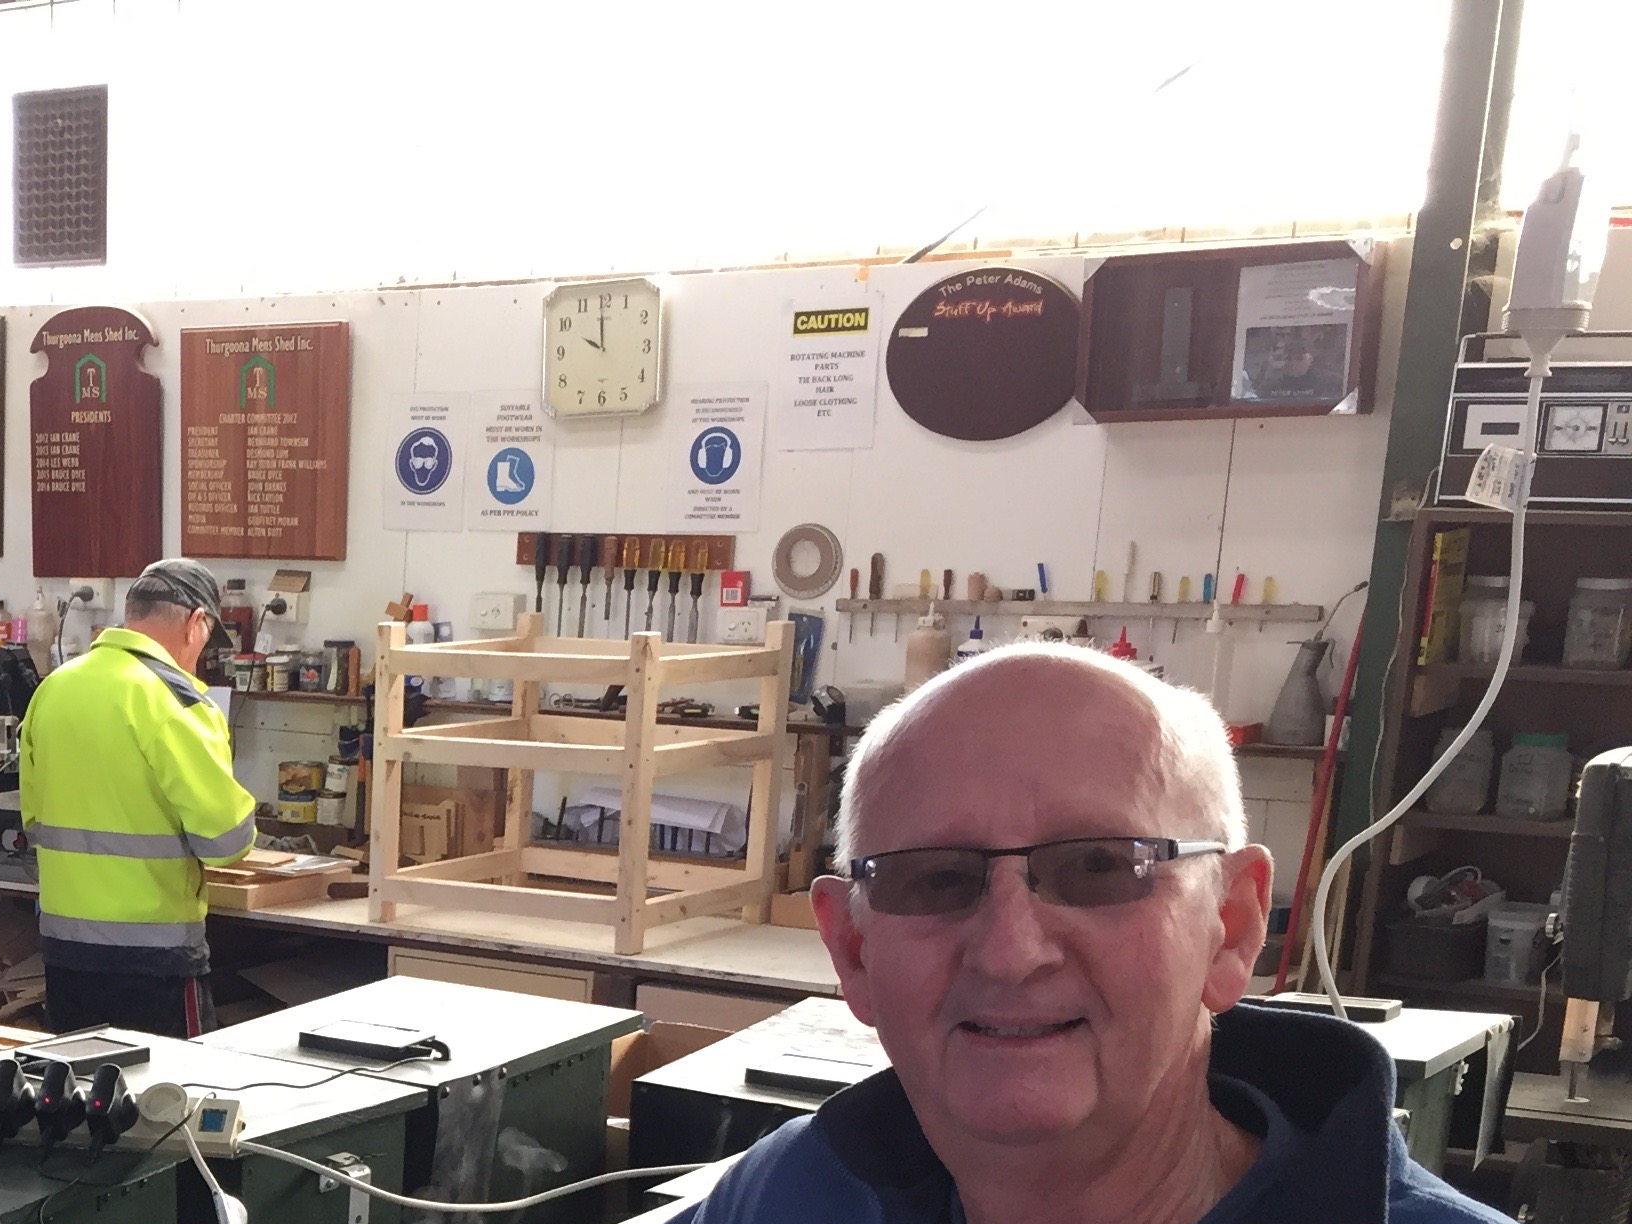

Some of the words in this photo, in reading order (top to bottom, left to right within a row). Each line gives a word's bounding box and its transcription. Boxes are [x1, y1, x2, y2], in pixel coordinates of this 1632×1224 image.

[938, 282, 963, 297] The
[966, 274, 1001, 286] Peter
[1004, 273, 1043, 295] Adams
[577, 298, 588, 313] 11
[599, 293, 612, 309] 12
[623, 294, 628, 309] 1
[640, 309, 648, 325] 2
[977, 301, 997, 321] Up
[1002, 299, 1043, 317] Award
[559, 316, 572, 332] 10
[796, 312, 866, 331] CAUTION
[42, 331, 82, 349] Thurgoona
[83, 328, 103, 342] Mens
[104, 326, 123, 342] Shed
[125, 325, 139, 340] Inc.
[205, 338, 249, 358] Thurgoona
[251, 337, 273, 352] Mens
[274, 335, 295, 352] Shed
[297, 335, 313, 351] Inc.
[556, 345, 565, 361] 9
[642, 338, 651, 354] 3
[790, 352, 829, 361] ROTATING
[831, 350, 866, 359] MACHINE
[87, 367, 96, 387] T
[253, 367, 263, 387] T
[558, 373, 567, 388] 8
[637, 367, 645, 383] 4
[798, 376, 810, 384] TIE
[812, 375, 832, 383] BACK
[834, 374, 854, 382] LONG
[81, 386, 100, 399] MS
[247, 387, 267, 399] MS
[577, 389, 585, 405] 7
[597, 389, 606, 406] 6
[619, 386, 628, 402] 5
[816, 386, 834, 394] HAIR
[500, 404, 531, 412] SUITABLE
[794, 399, 818, 407] LOOSE
[819, 398, 857, 406] CLOTHING
[71, 410, 112, 423] PRESIDENTS
[218, 412, 246, 424] CHARTER
[247, 412, 282, 424] COMMITTEE
[817, 409, 832, 417] ETC
[36, 432, 49, 443] 2012
[50, 432, 60, 443] IAN
[61, 432, 80, 443] CRANE
[188, 426, 218, 435] PRESIDENT
[50, 444, 60, 456] IAN
[61, 444, 80, 456] CRANE
[50, 457, 60, 468] LES
